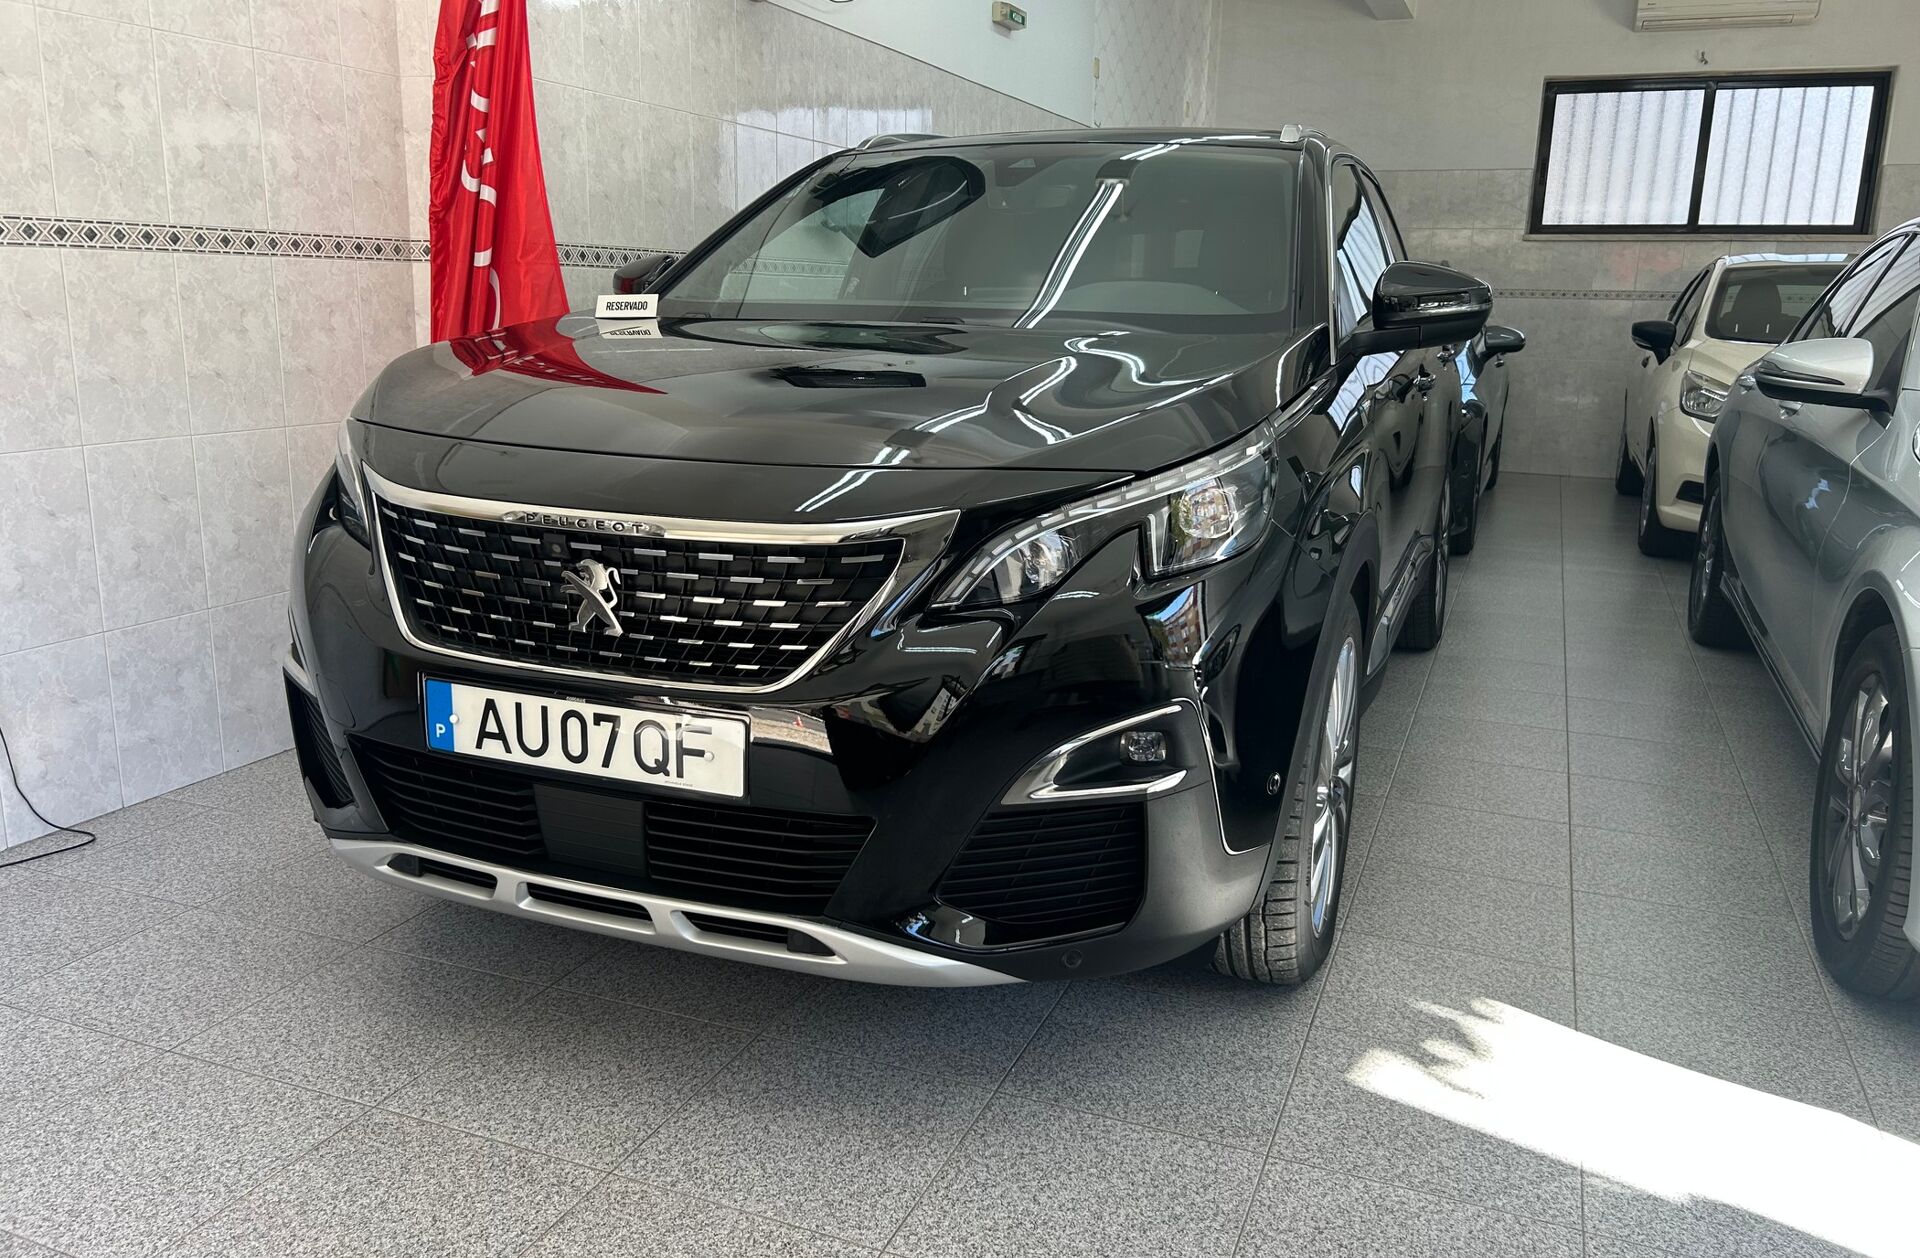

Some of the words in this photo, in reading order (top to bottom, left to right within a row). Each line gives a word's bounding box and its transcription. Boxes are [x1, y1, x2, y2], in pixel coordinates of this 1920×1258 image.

[605, 301, 648, 311] RESERVADO
[524, 512, 644, 534] PEUGEOT
[435, 723, 446, 739] P
